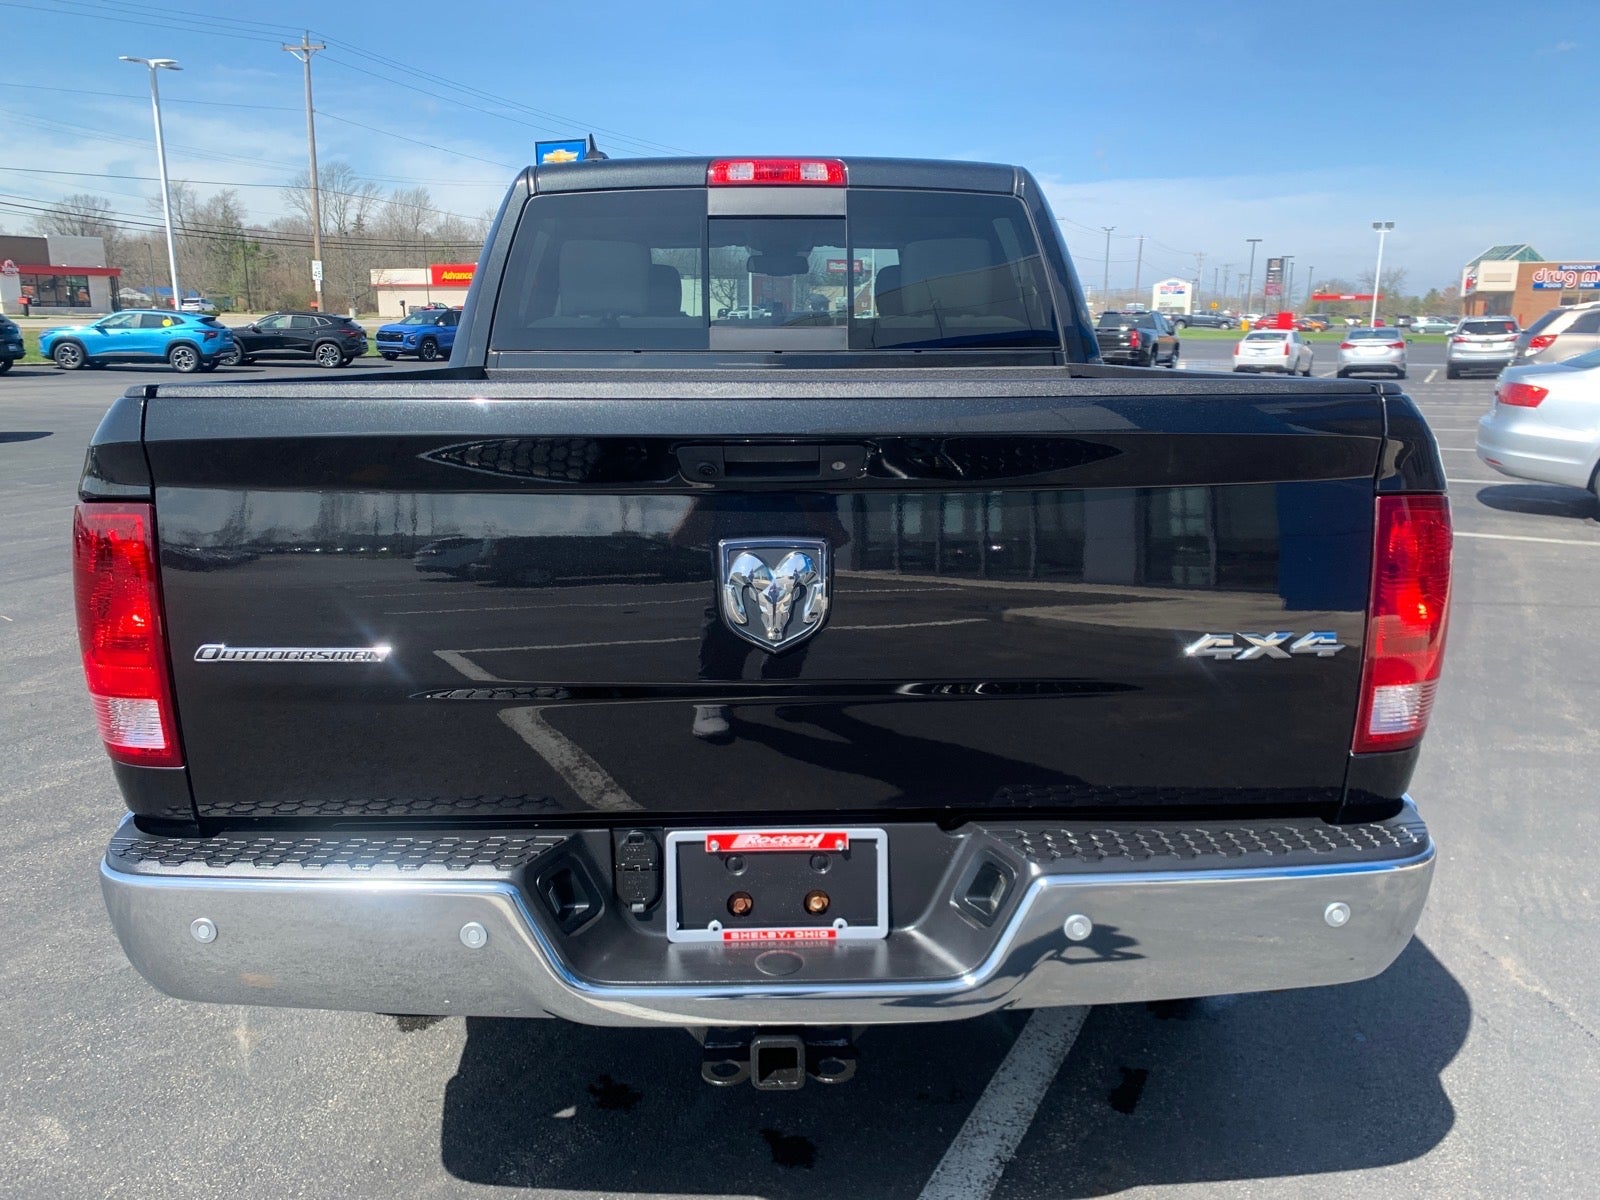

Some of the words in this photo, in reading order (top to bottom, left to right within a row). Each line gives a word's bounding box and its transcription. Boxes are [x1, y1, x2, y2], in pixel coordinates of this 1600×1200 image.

[313, 270, 321, 278] 45
[441, 271, 473, 280] Advance
[1532, 267, 1577, 288] drug
[1580, 270, 1600, 283] m
[730, 931, 792, 940] SHELBY,
[794, 930, 829, 939] OHIO
